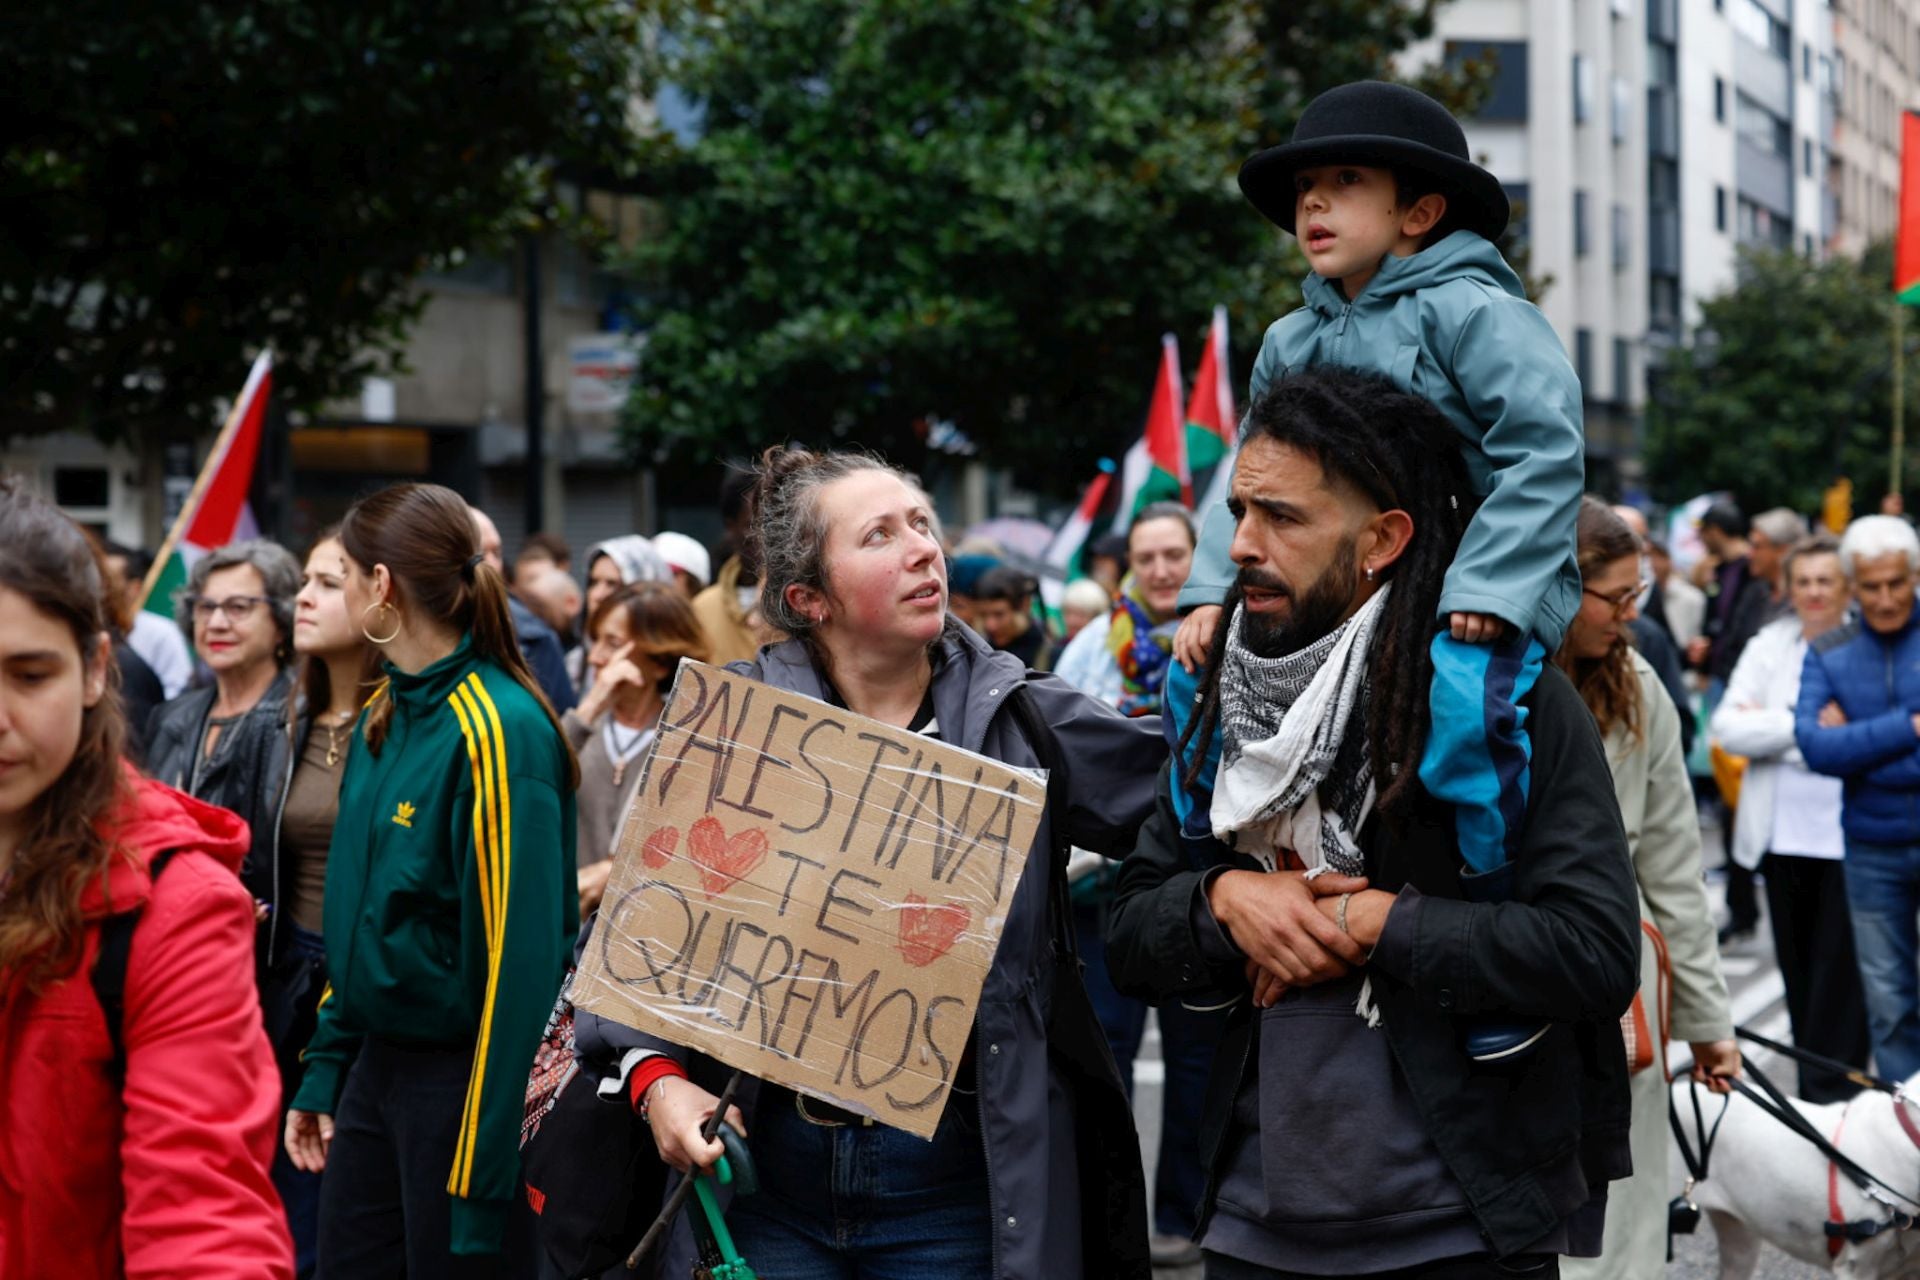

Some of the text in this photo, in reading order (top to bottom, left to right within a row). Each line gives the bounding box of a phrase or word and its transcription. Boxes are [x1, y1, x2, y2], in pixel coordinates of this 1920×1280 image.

[639, 666, 1020, 902] PALESTINA
[777, 850, 882, 944] TE
[602, 880, 964, 1111] QUEREMOS
